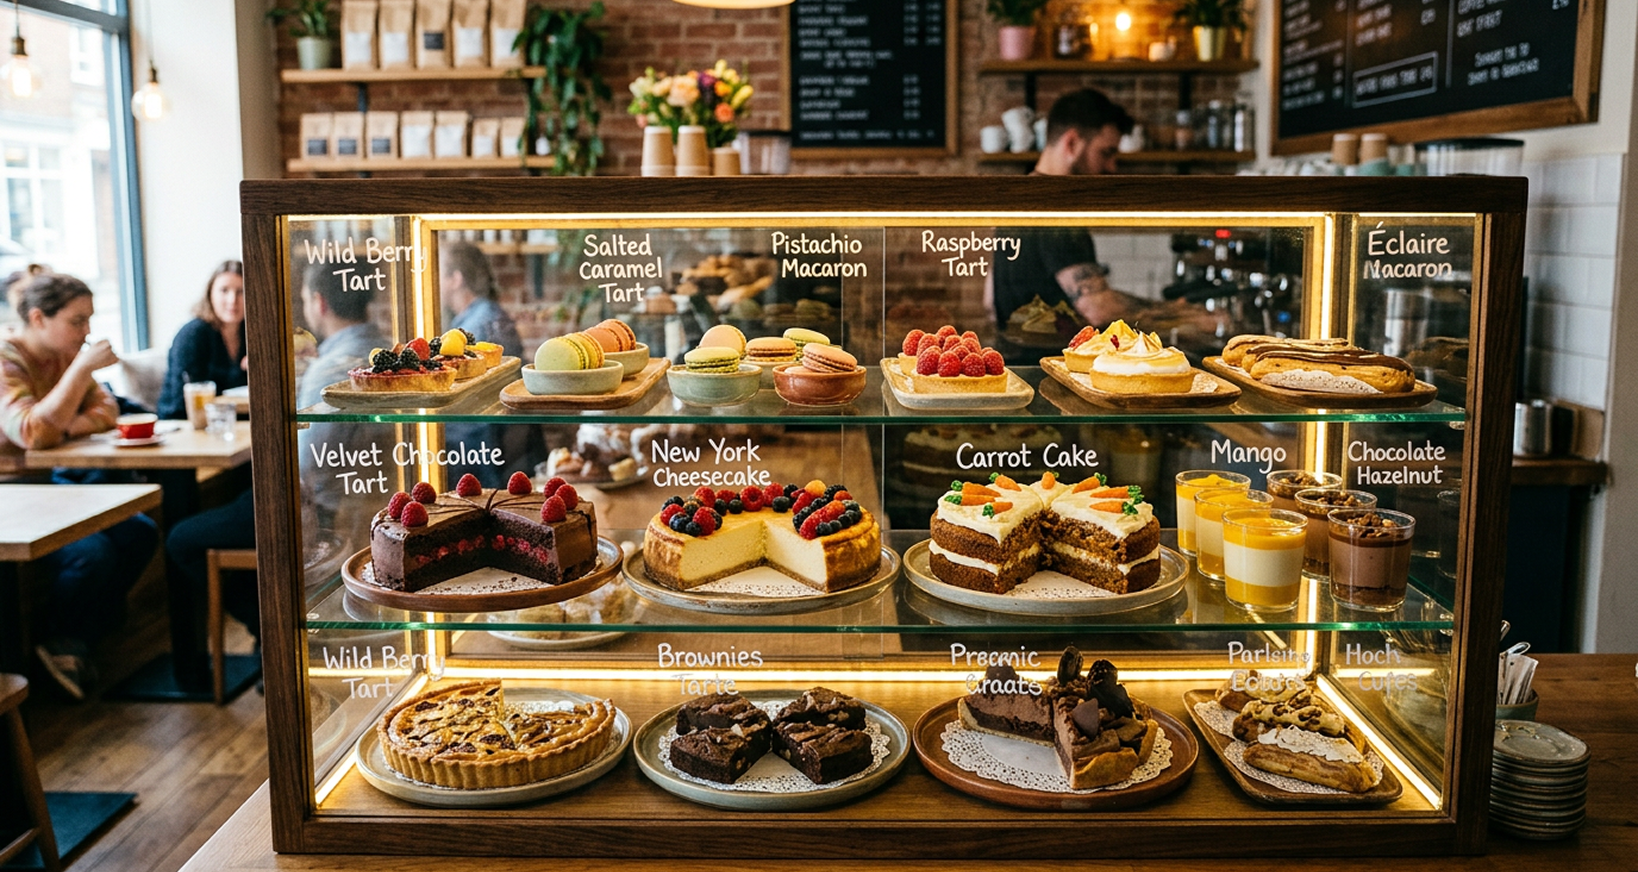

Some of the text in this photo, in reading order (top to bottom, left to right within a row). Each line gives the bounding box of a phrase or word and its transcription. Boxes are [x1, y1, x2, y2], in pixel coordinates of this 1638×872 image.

[583, 233, 653, 257] Salted
[771, 230, 863, 255] Pistachio
[921, 230, 1022, 261] Raspberry
[1367, 220, 1451, 256] Éclaire
[303, 236, 428, 274] Wild Berry
[941, 256, 989, 277] Tart
[332, 267, 387, 293] Tart
[579, 256, 663, 280] Caramel
[781, 258, 868, 278] Macaron
[1363, 259, 1453, 280] Macaron
[598, 282, 645, 304] Tart
[310, 441, 506, 468] Velvet Chocolate
[651, 437, 762, 464] New York
[955, 441, 1099, 470] Carrot Cake
[1210, 439, 1287, 475] Mango
[1347, 440, 1447, 463] Chocolate
[335, 470, 389, 495] Tart
[652, 465, 773, 489] Cheesecake
[1357, 463, 1444, 486] Hazelnut
[322, 645, 373, 670] Wild
[657, 642, 764, 669] Brownies
[1345, 642, 1401, 666] Hoch
[341, 676, 394, 700] Tart
